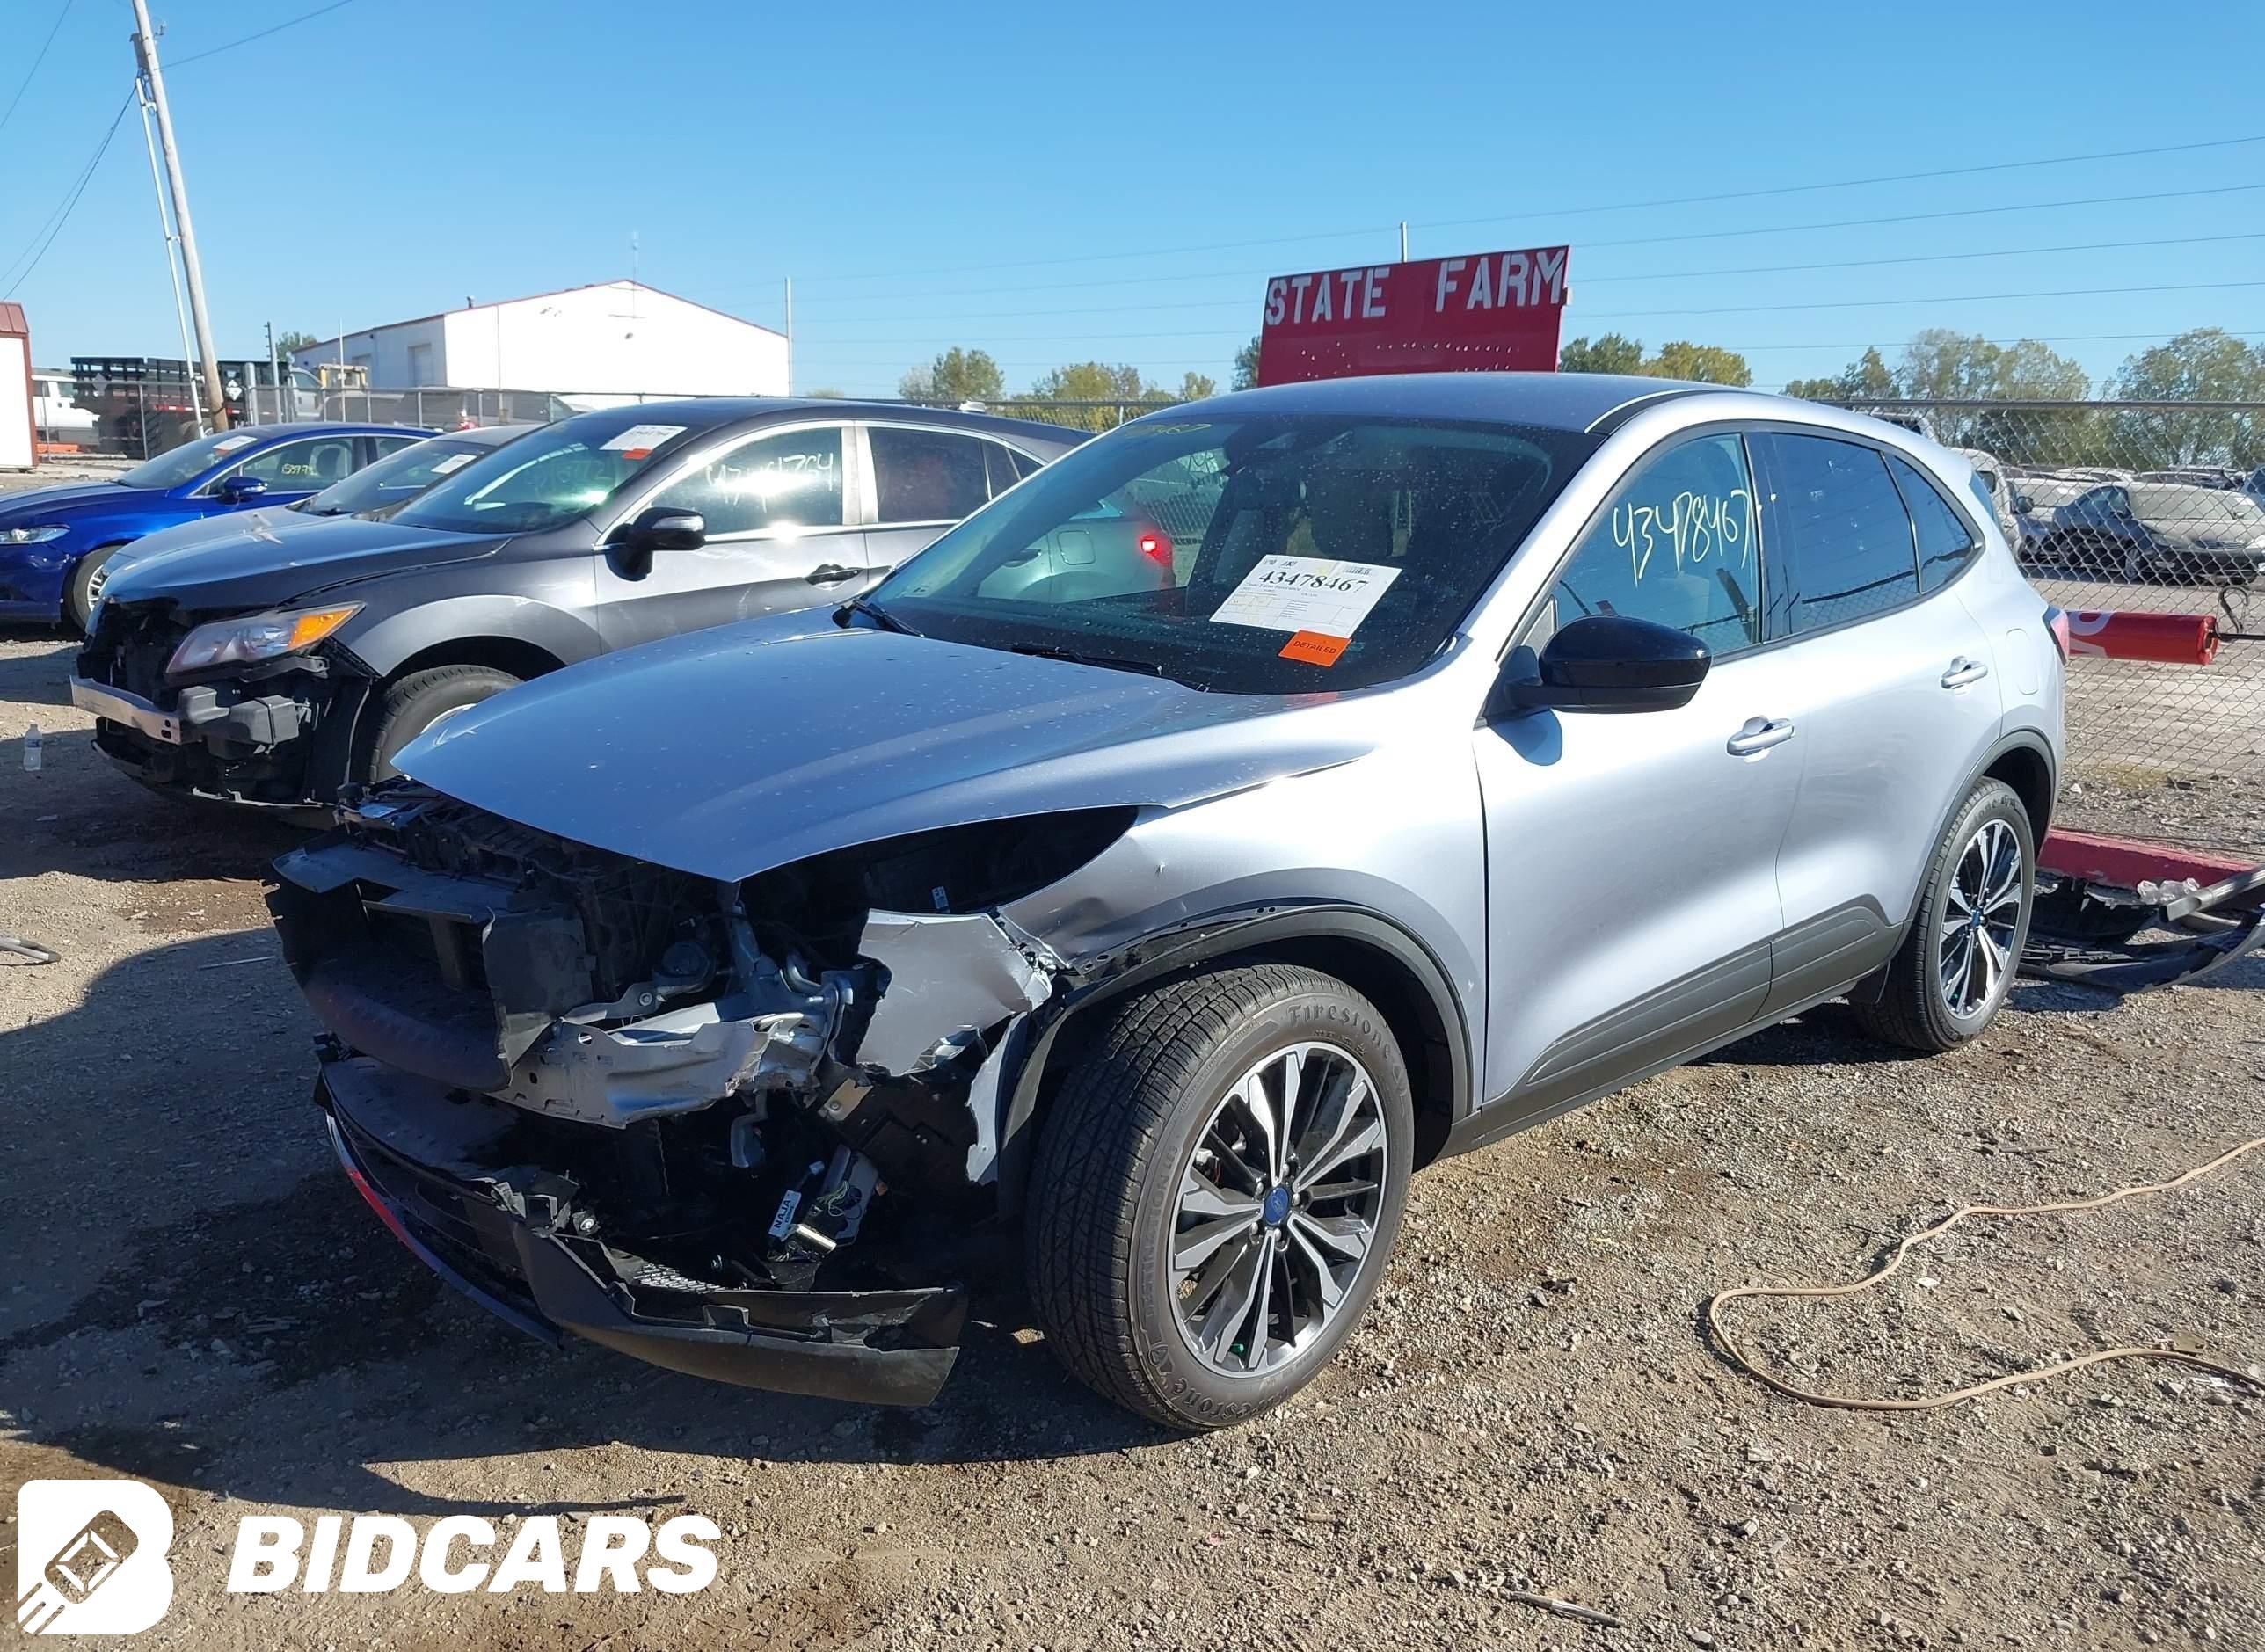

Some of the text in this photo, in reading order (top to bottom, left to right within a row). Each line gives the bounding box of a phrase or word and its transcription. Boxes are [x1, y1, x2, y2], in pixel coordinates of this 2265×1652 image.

[1264, 250, 1566, 325] STATE FARM
[1613, 489, 1752, 588] 43478467
[1258, 571, 1369, 593] 43478467
[1293, 640, 1338, 655] DETAILED
[1286, 1004, 1392, 1059] Firestone
[774, 1199, 791, 1228] NAJA
